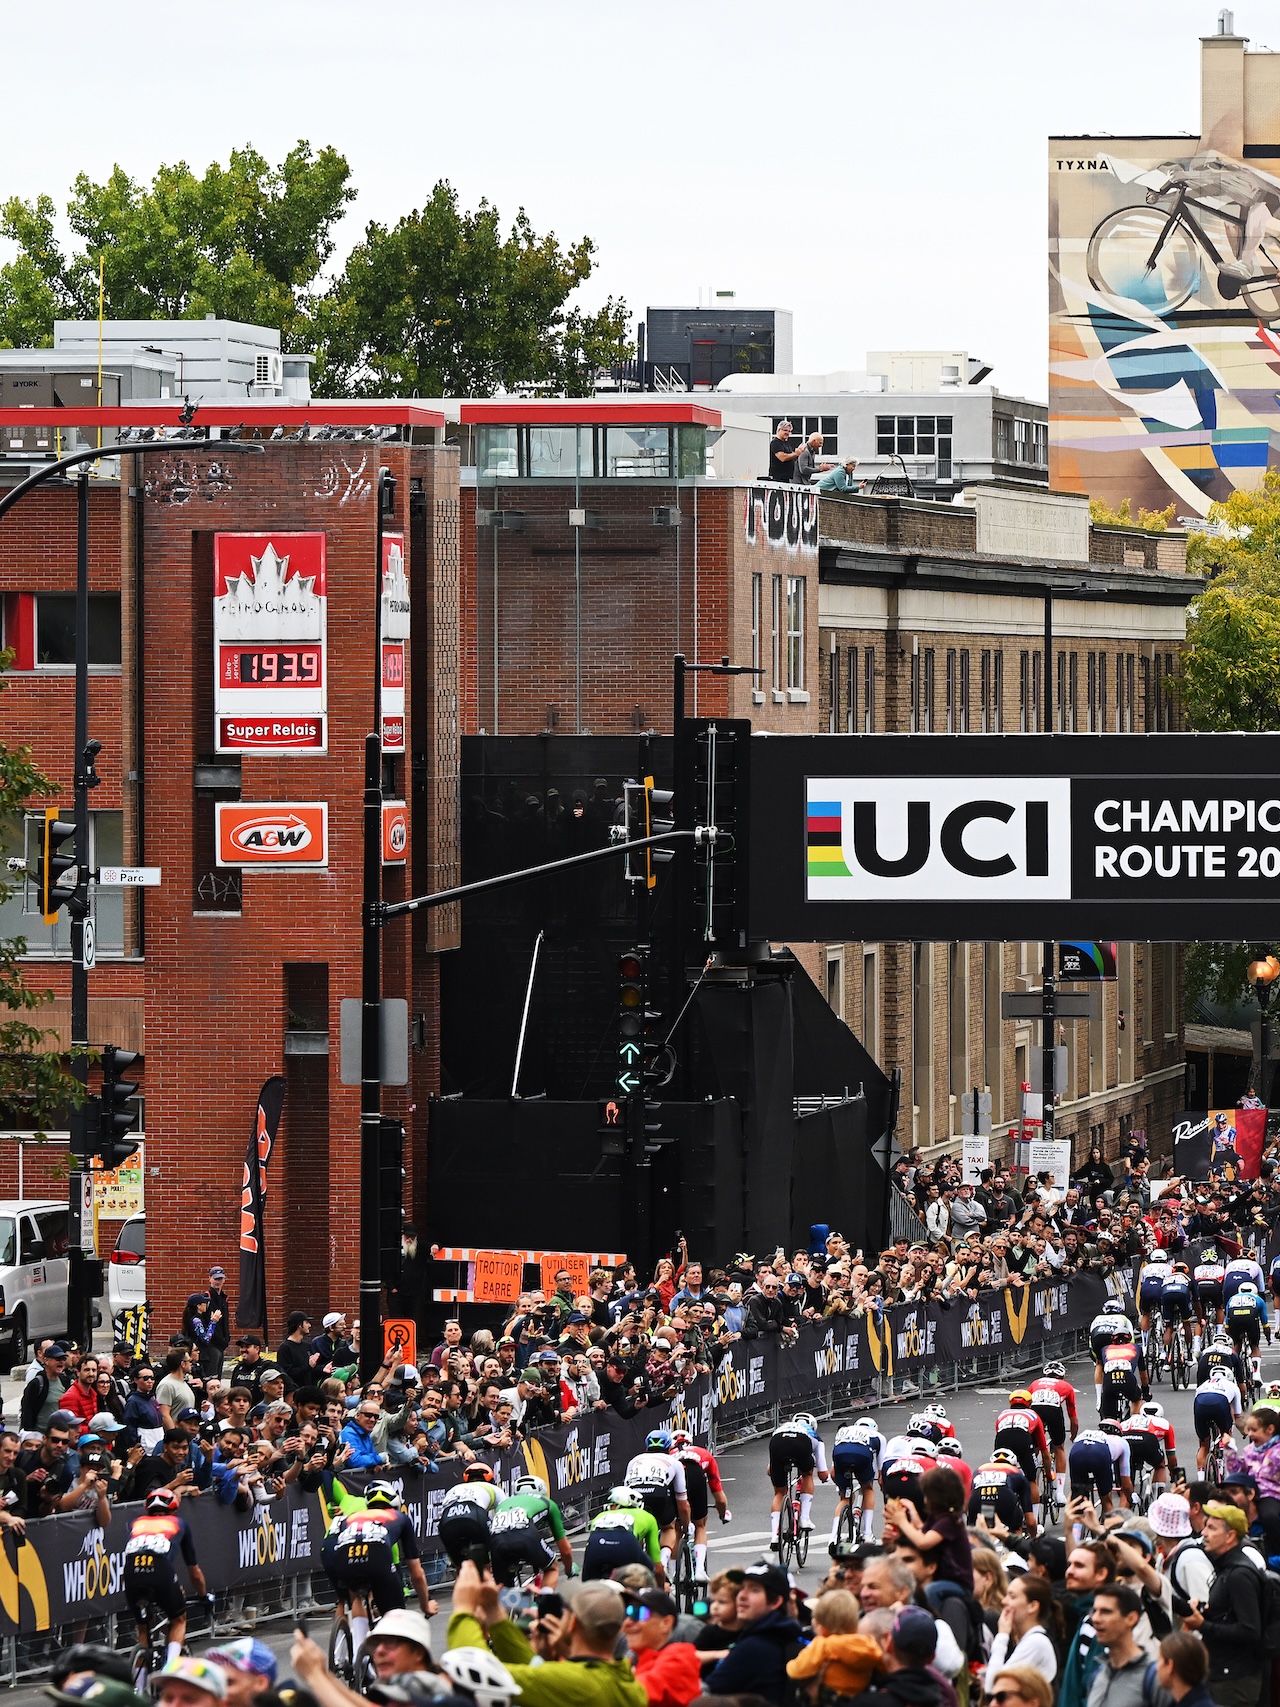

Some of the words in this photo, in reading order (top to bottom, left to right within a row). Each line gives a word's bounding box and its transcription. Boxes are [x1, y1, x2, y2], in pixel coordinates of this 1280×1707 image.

[1056, 160, 1108, 170] TYXNA
[226, 723, 270, 739] Super
[272, 723, 317, 736] Relais
[243, 830, 305, 847] A&W
[853, 800, 1049, 878] UCI
[1095, 845, 1226, 879] ROUTE
[120, 873, 144, 882] Parc
[479, 1260, 519, 1277] TROTTOIR
[547, 1260, 585, 1270] UTILISER
[483, 1281, 512, 1297] BARRÉ
[555, 1447, 590, 1490] WHOOSH
[238, 1522, 287, 1569] WHOOSH
[63, 1552, 127, 1604] WHOOSH
